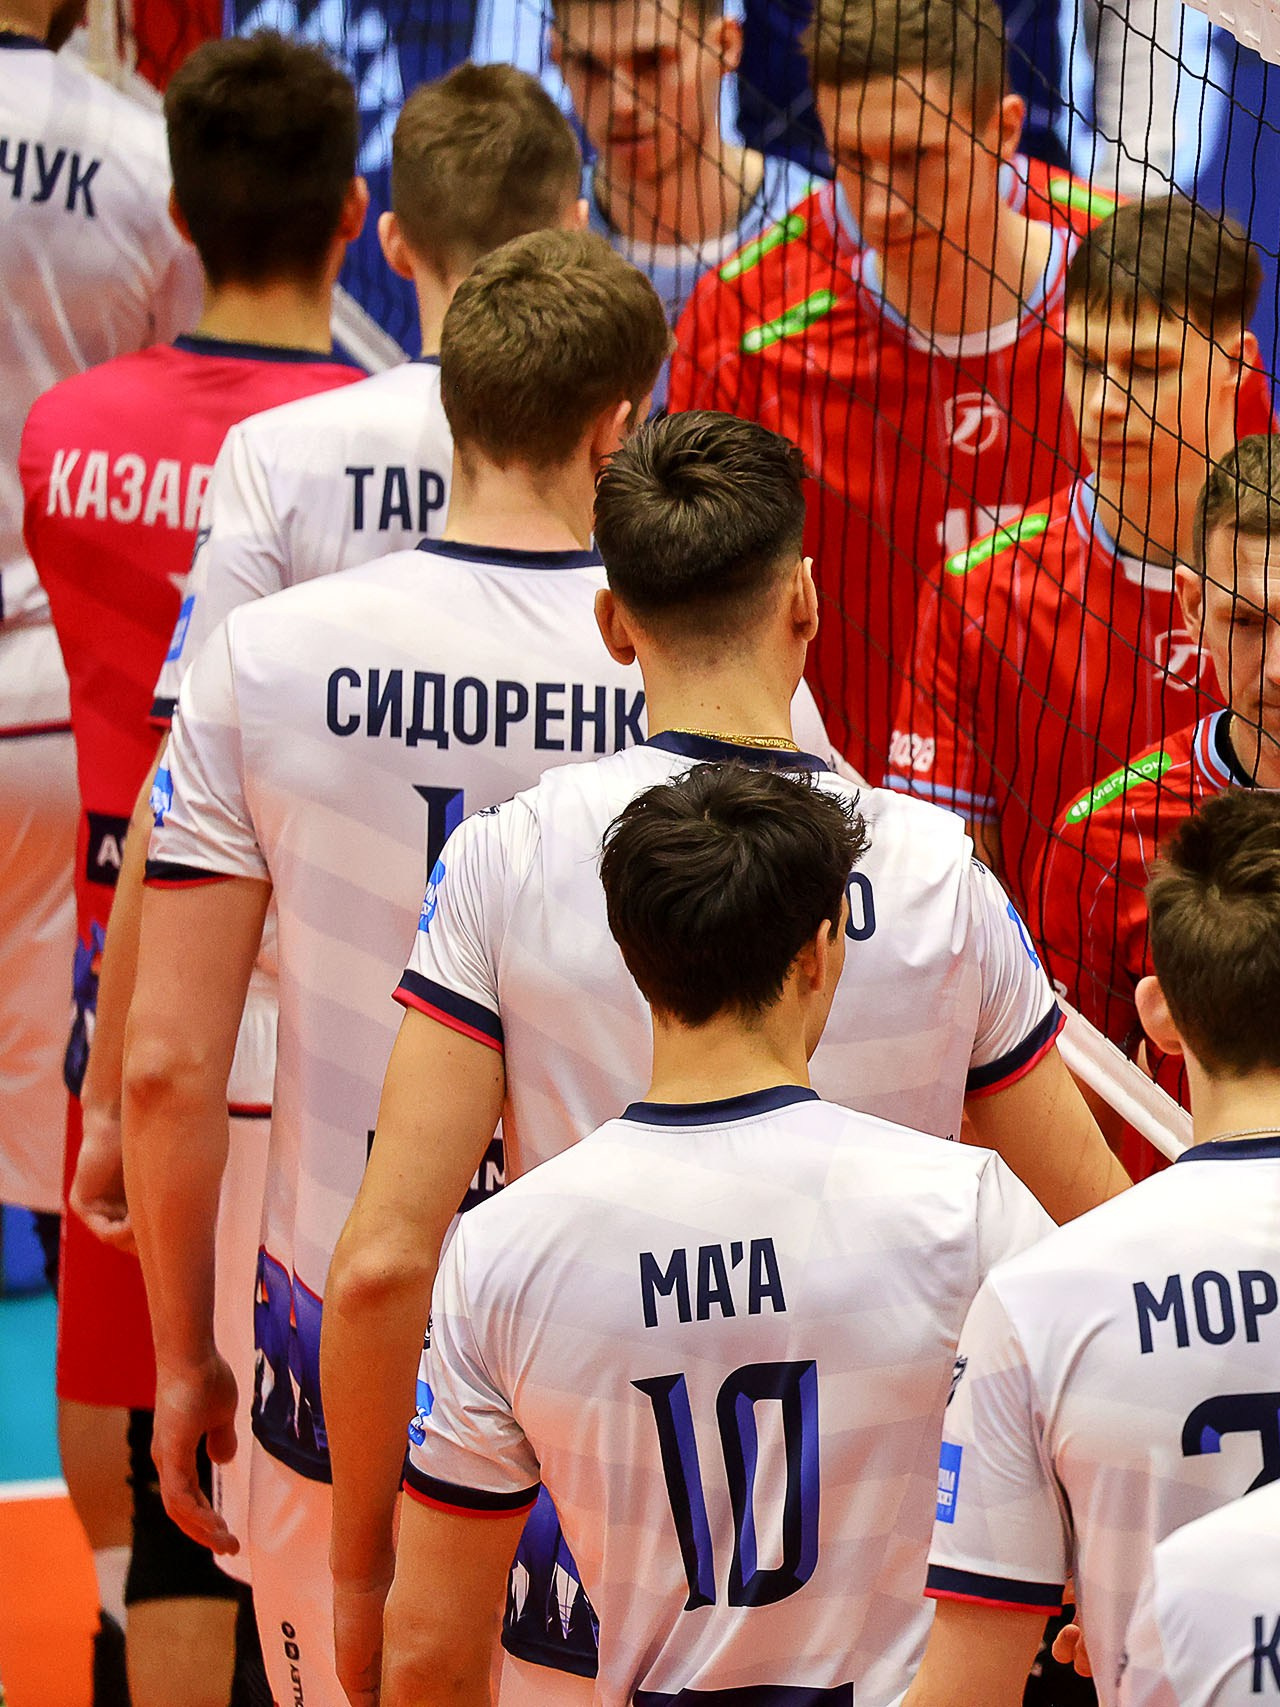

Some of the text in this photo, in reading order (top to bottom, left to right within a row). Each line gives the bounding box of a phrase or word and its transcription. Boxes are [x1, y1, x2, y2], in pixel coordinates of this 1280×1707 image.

[345, 466, 445, 533] ТАР
[326, 666, 647, 754] СИДОРЕНК
[630, 1359, 819, 1612] 10
